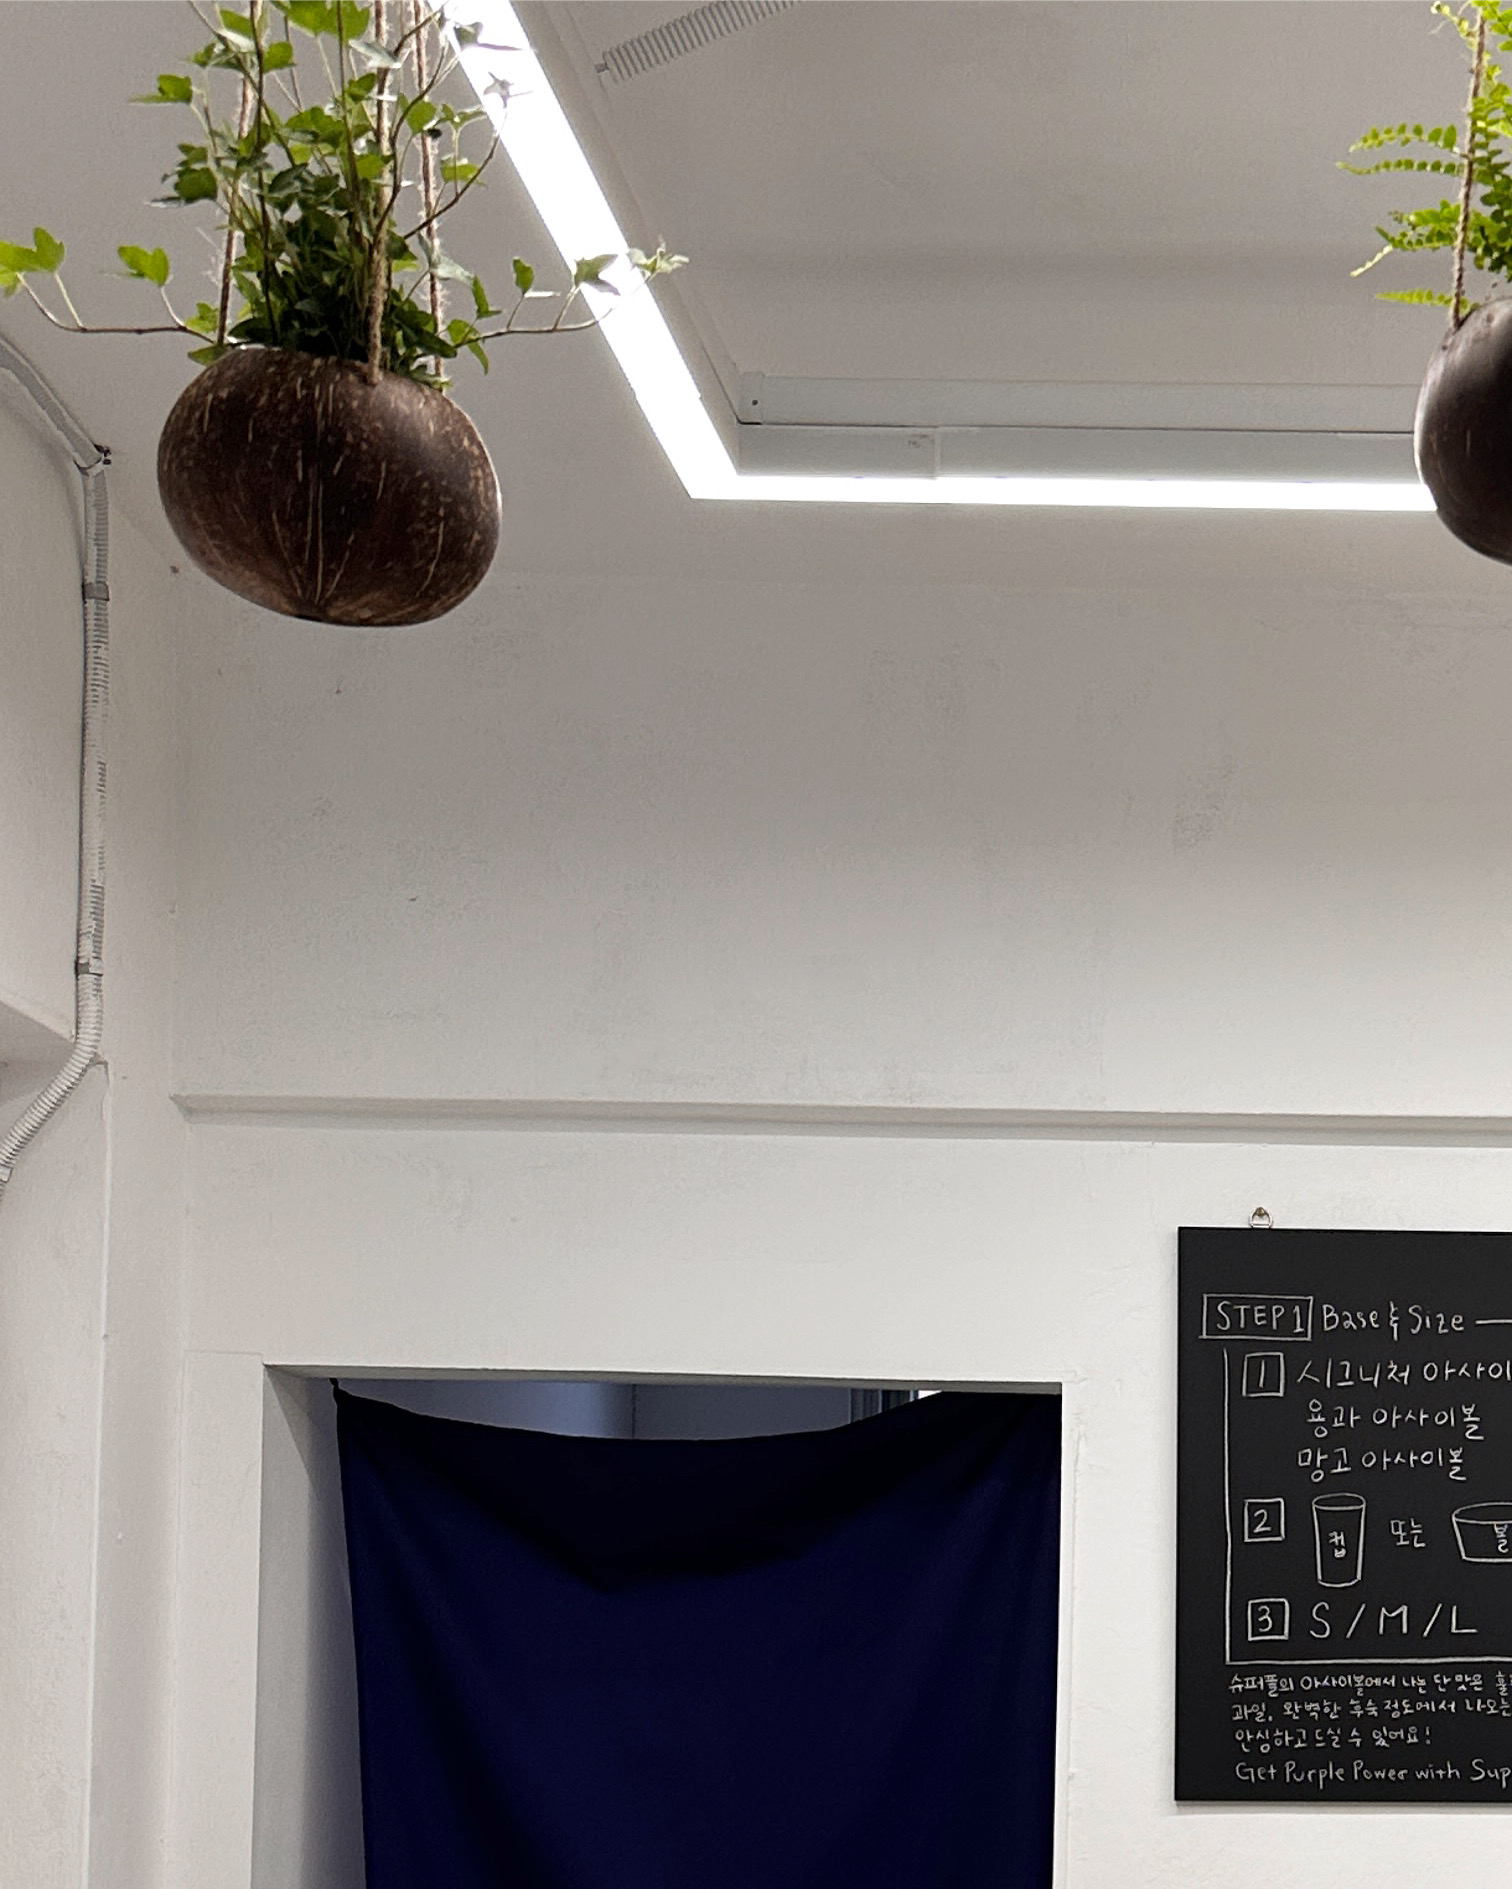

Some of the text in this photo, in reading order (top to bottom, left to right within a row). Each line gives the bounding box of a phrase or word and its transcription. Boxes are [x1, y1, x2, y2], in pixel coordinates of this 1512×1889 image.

[1322, 1304, 1380, 1331] Base
[1408, 1304, 1465, 1334] Size
[1297, 1358, 1410, 1388] 시그니처
[1307, 1398, 1484, 1440] 용과 아사이볼
[1298, 1447, 1467, 1483] 망고 아사이볼
[1253, 1509, 1271, 1533] 2
[1390, 1518, 1426, 1548] 또는
[1258, 1605, 1273, 1632] 3
[1229, 1674, 1294, 1698] 슈퍼플의
[1300, 1674, 1396, 1697] 아사이볼에서
[1402, 1675, 1427, 1694] 나는
[1283, 1699, 1339, 1720] 완벽한
[1349, 1728, 1362, 1747] 수
[1235, 1762, 1277, 1783] Get
[1285, 1761, 1344, 1789] Purple
[1353, 1759, 1408, 1780] Power
[1415, 1761, 1460, 1779] with
